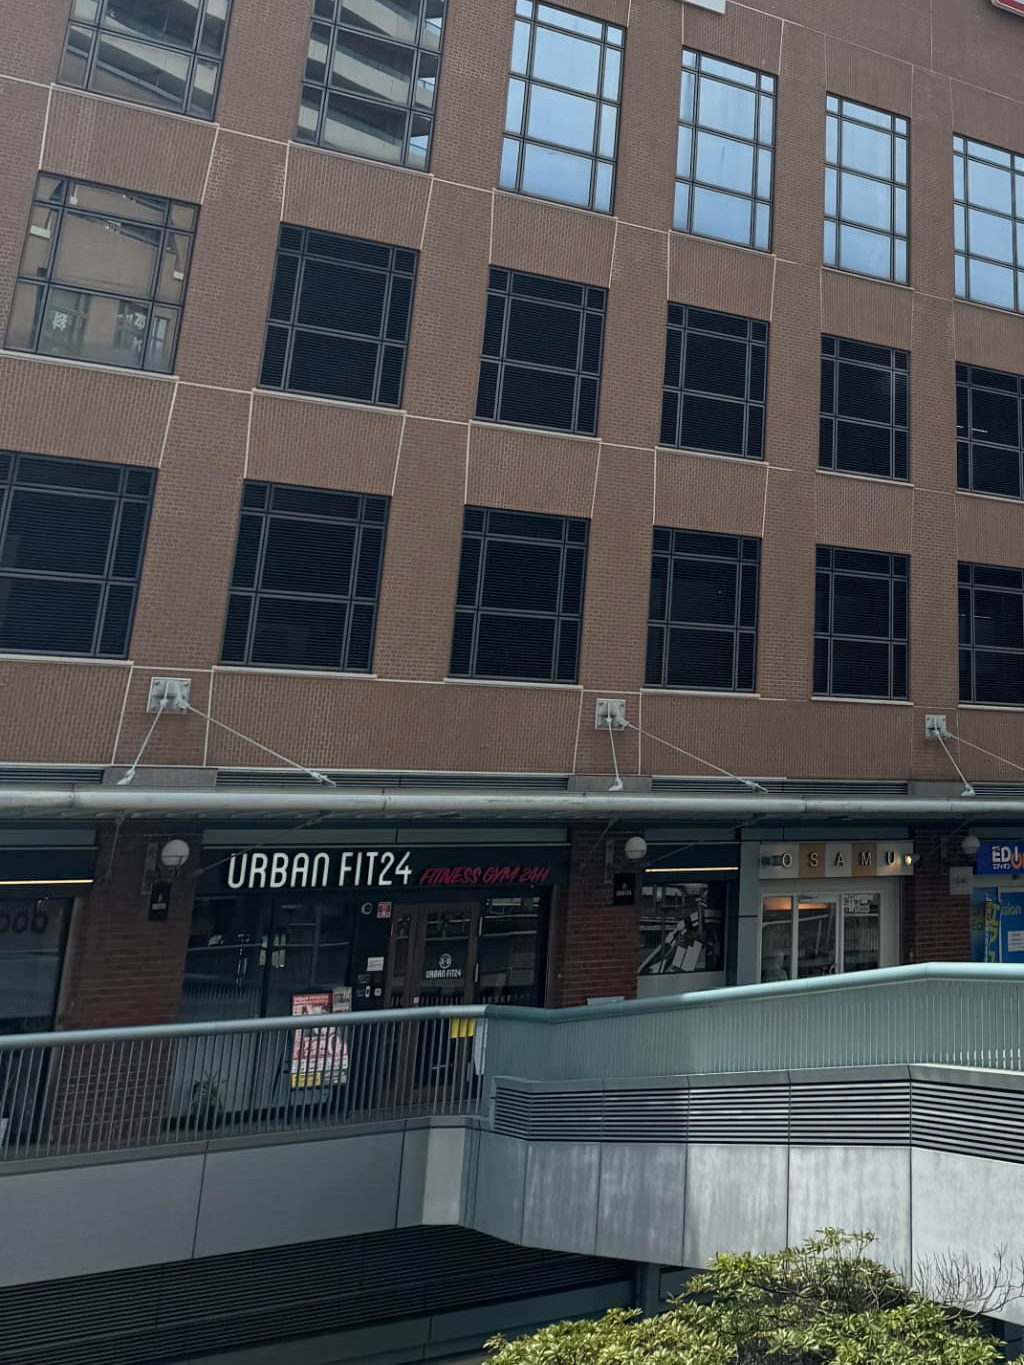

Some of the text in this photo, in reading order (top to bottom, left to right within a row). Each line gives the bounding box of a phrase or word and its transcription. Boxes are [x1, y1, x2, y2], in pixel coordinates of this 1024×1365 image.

[782, 849, 897, 868] OSAMU
[227, 850, 413, 889] URBAN FIT24
[420, 866, 550, 884] FITNESS GYM 24H
